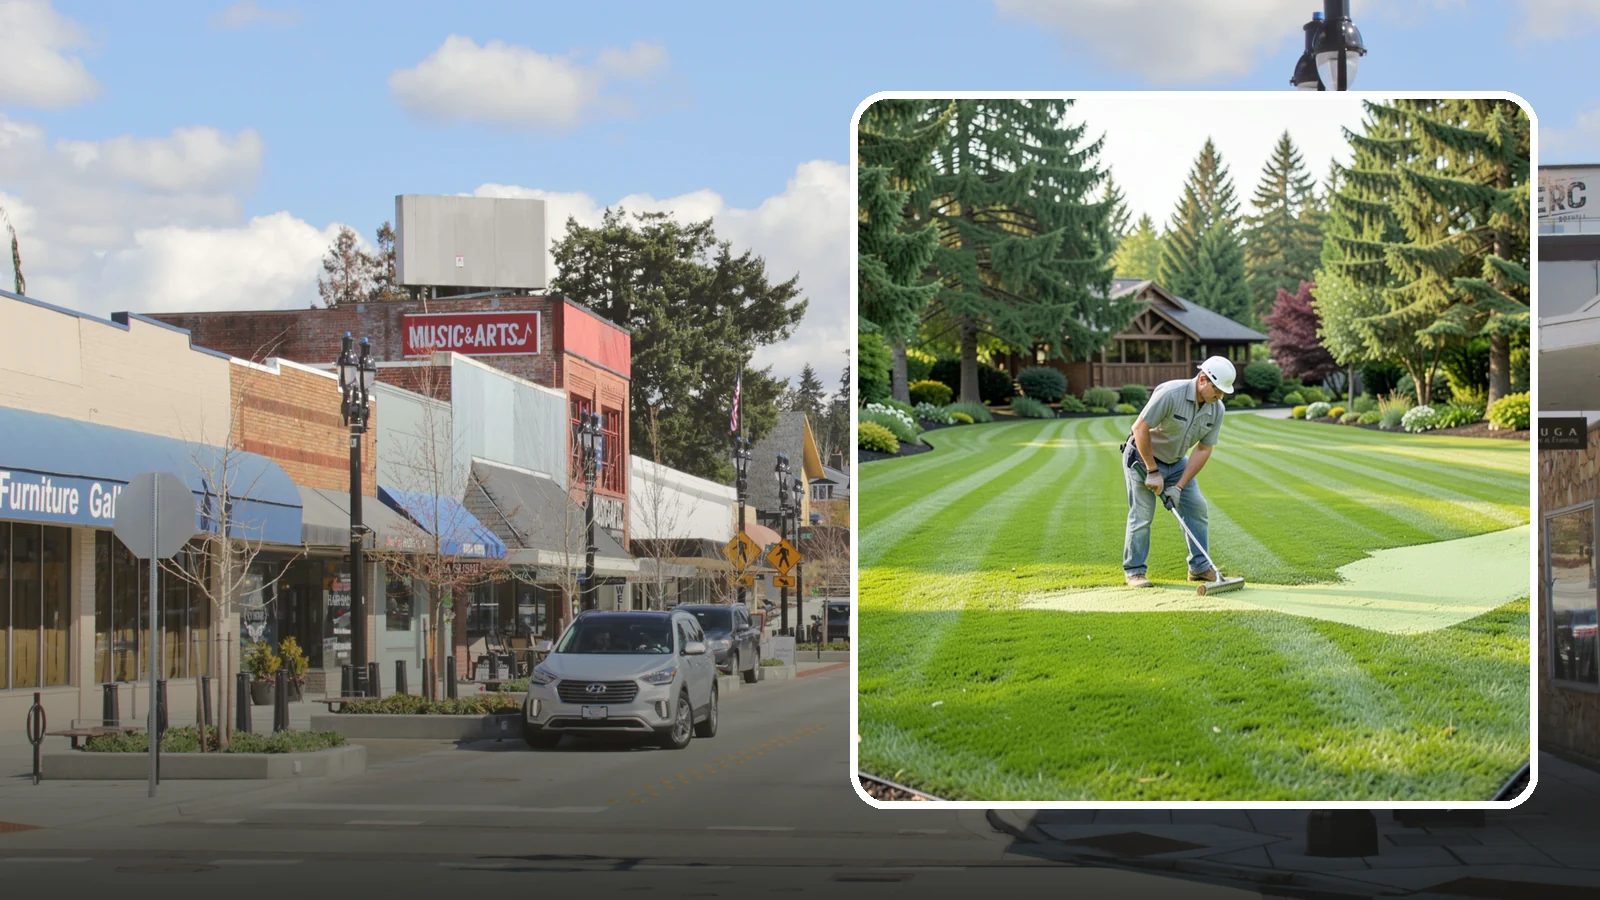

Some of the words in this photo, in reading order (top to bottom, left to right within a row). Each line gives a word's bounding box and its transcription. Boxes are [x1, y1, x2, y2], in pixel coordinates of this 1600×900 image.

[409, 323, 519, 348] MUSIC&ARTS
[1540, 427, 1577, 436] UGA
[0, 472, 79, 515] Furniture
[90, 482, 122, 519] Gal
[453, 563, 479, 574] SUSHI
